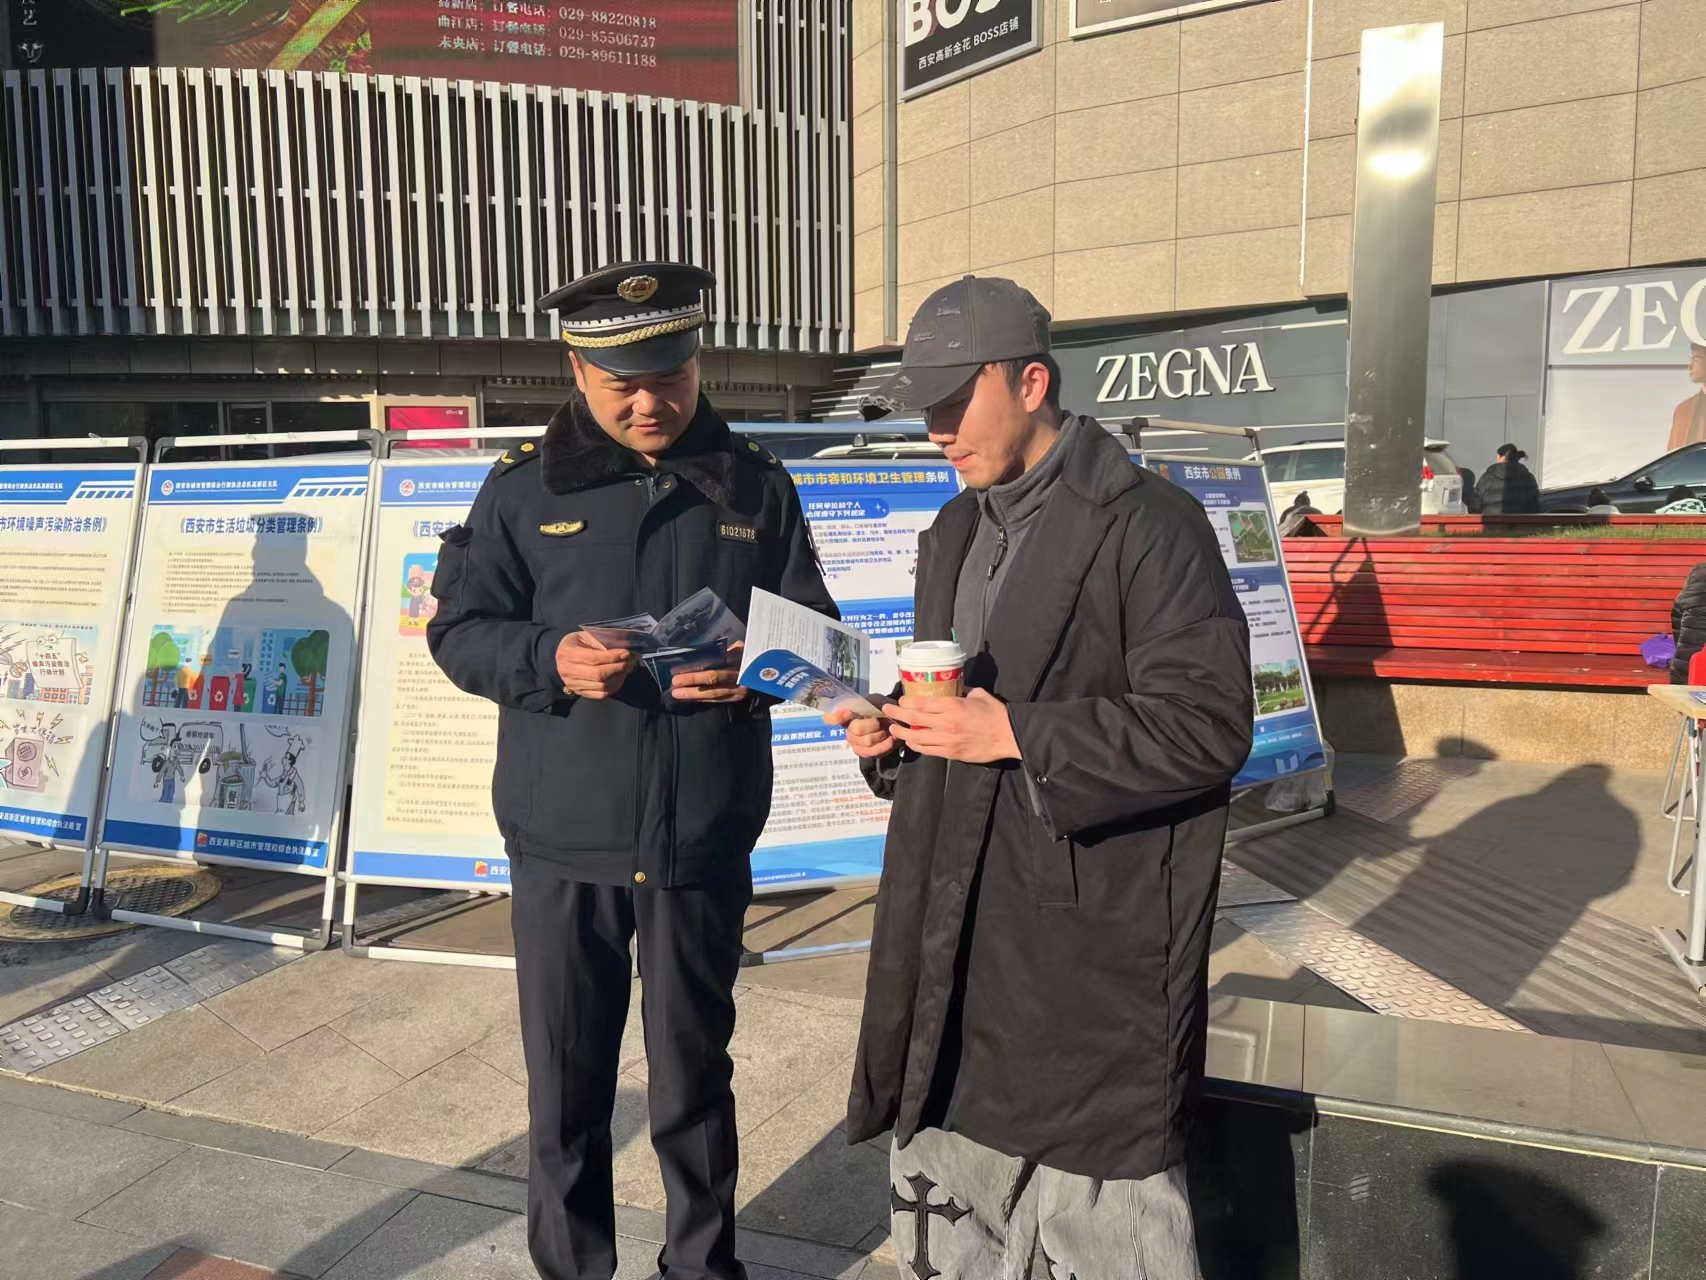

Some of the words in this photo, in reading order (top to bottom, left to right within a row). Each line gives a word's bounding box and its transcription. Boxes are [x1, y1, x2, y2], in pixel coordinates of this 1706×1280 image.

[559, 6, 657, 29] 029-88220818
[559, 26, 656, 48] 029-85506737
[918, 37, 971, 70] 西安高新金花
[973, 16, 1019, 46] BOSS店铺
[559, 45, 657, 67] 029-89611188
[1096, 342, 1275, 403] ZEGNA
[1184, 466, 1241, 480] 西安市公园条例
[180, 517, 323, 534] 《西安市生活垃圾分类管理条例》
